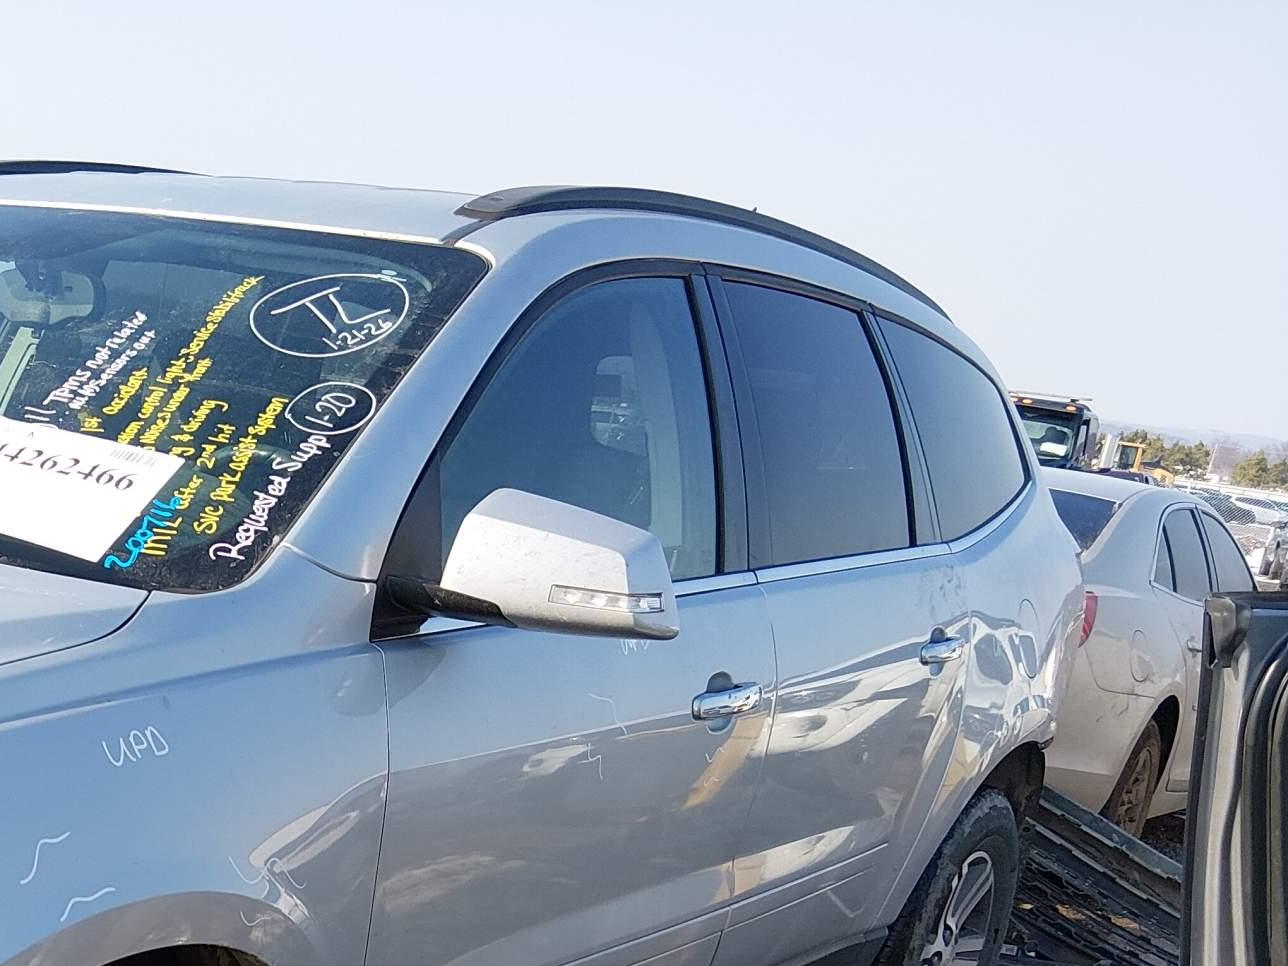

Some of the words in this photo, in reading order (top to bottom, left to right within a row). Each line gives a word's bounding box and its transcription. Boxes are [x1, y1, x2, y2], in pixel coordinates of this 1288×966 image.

[322, 319, 393, 350] 1-21-26
[305, 392, 357, 428] 1-20
[208, 423, 236, 445] hit
[208, 475, 291, 560] Requested
[101, 725, 169, 768] UPD
